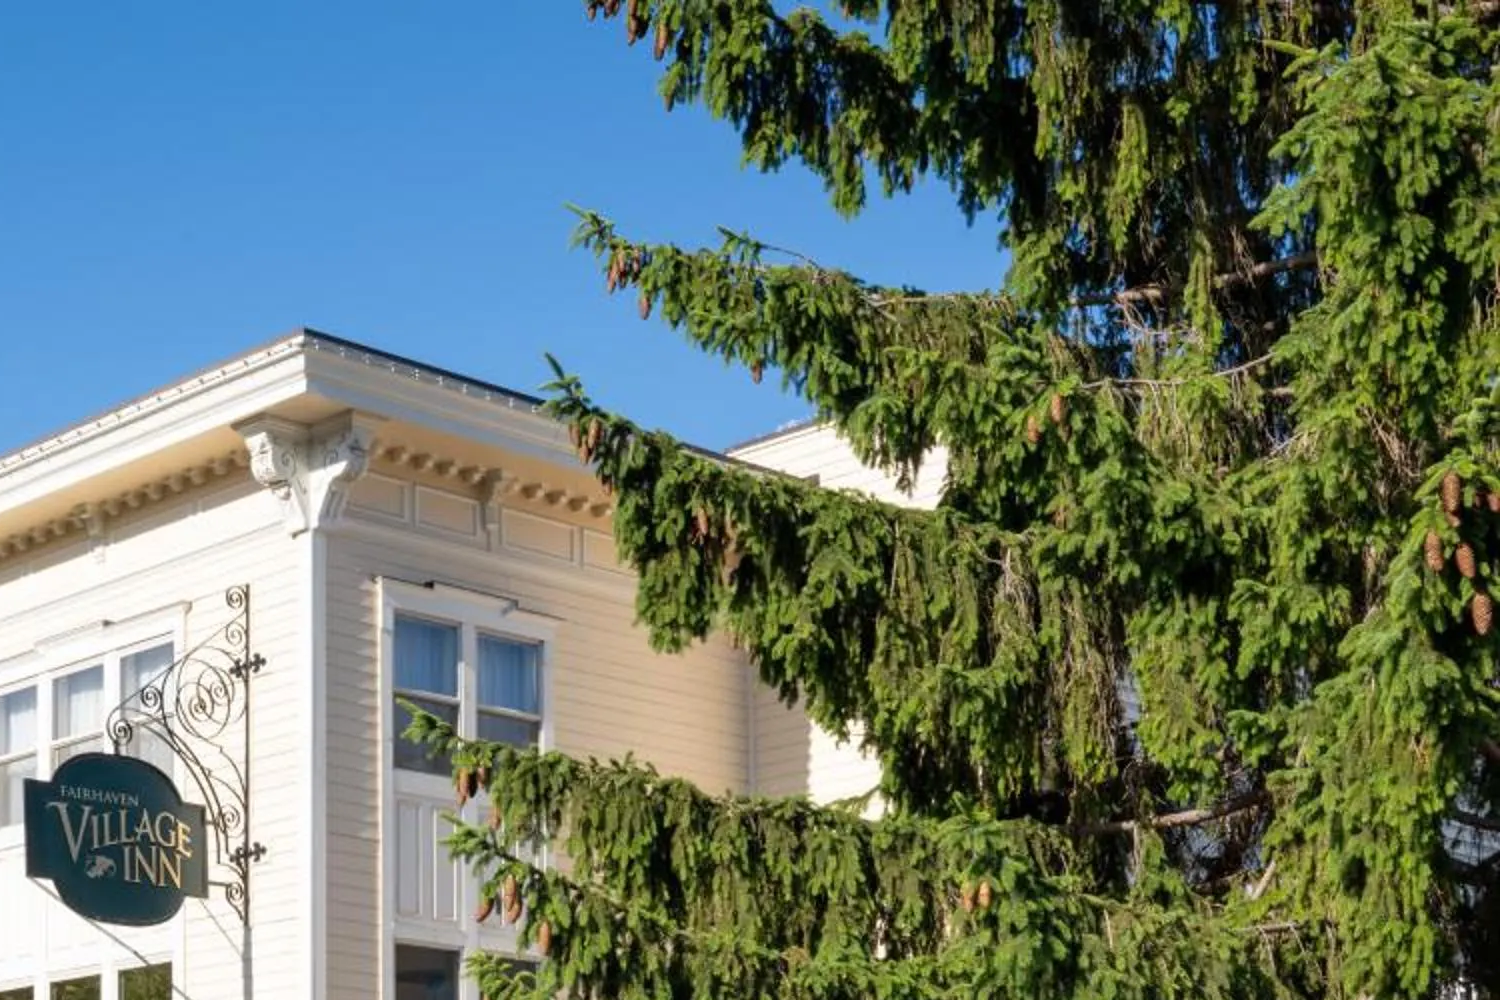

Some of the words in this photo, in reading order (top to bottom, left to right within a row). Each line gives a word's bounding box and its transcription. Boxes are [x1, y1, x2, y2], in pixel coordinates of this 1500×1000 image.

[60, 784, 139, 807] FAIRHAVEN
[46, 801, 192, 864] VILLAGE
[123, 845, 182, 888] INN
